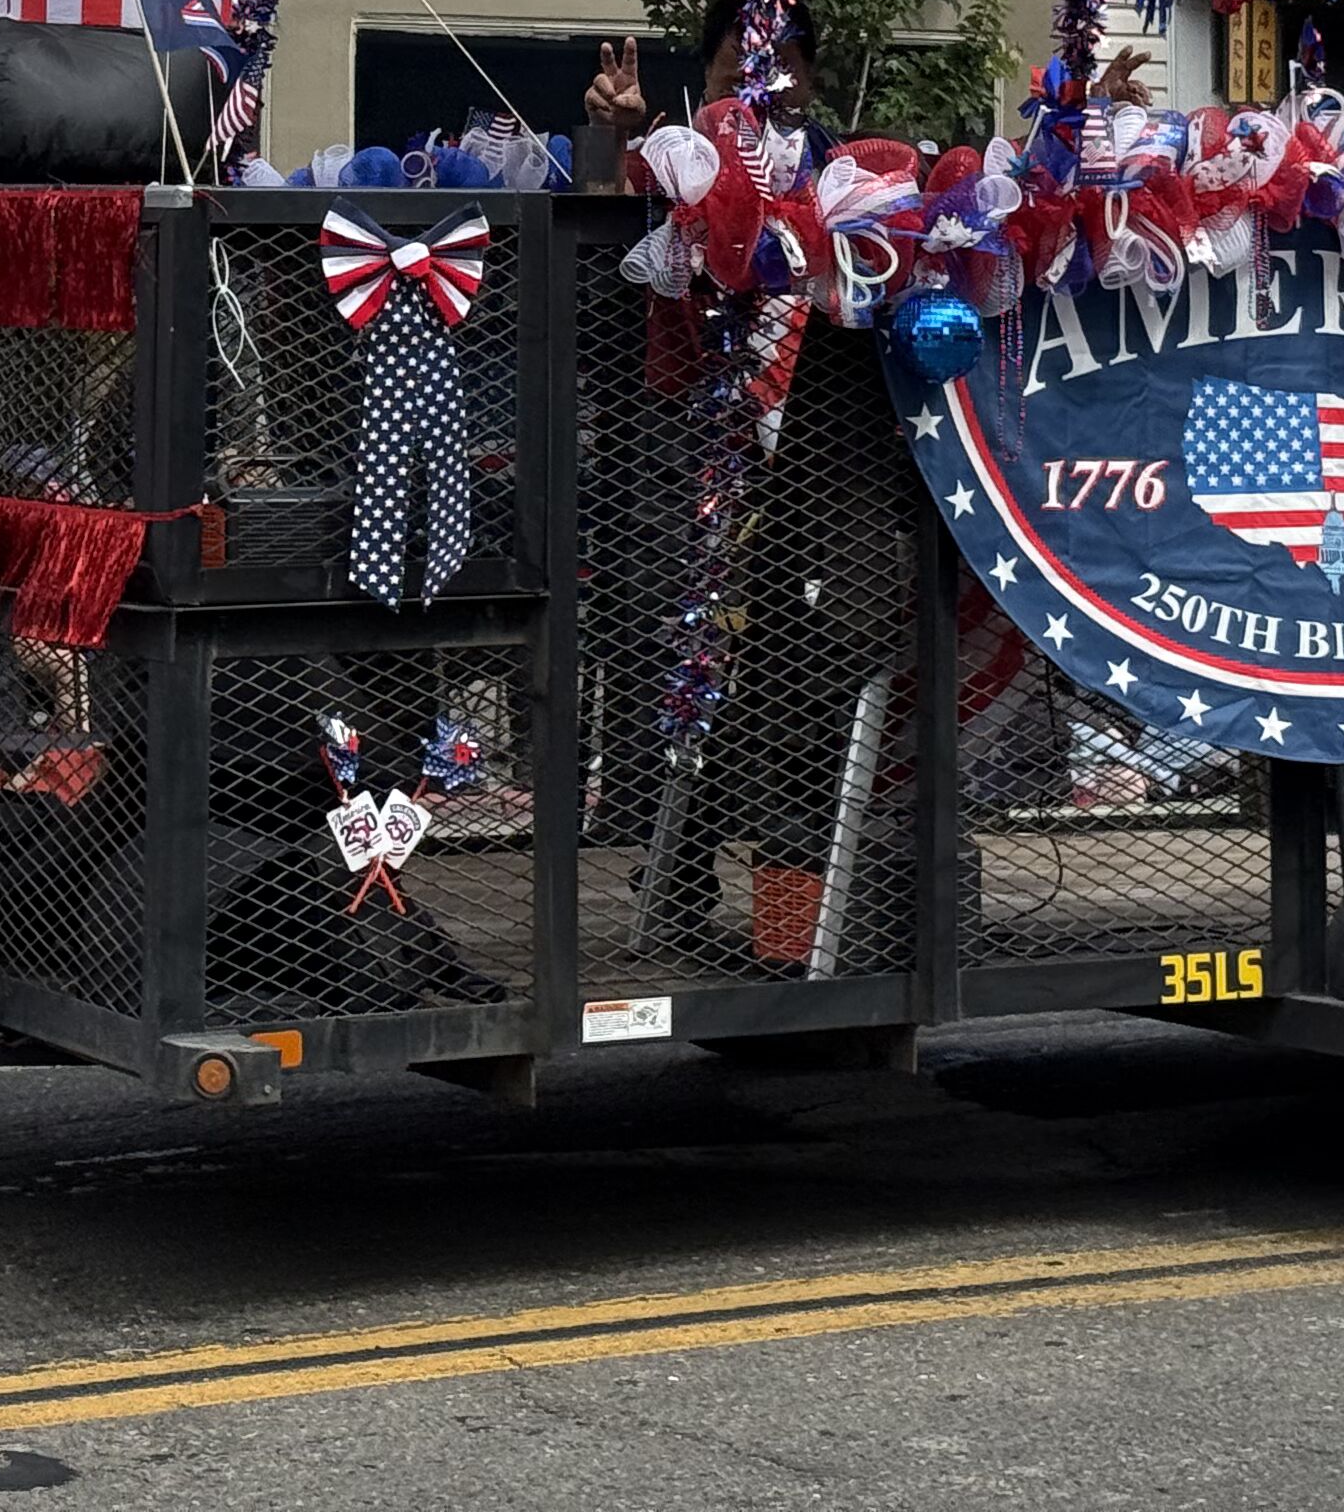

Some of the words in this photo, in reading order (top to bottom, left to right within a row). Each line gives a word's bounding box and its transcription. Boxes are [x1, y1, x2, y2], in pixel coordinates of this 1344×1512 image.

[1039, 459, 1168, 511] 1776
[1130, 571, 1283, 657] 250TH
[339, 811, 378, 847] 250
[1160, 948, 1264, 1005] 35LS
